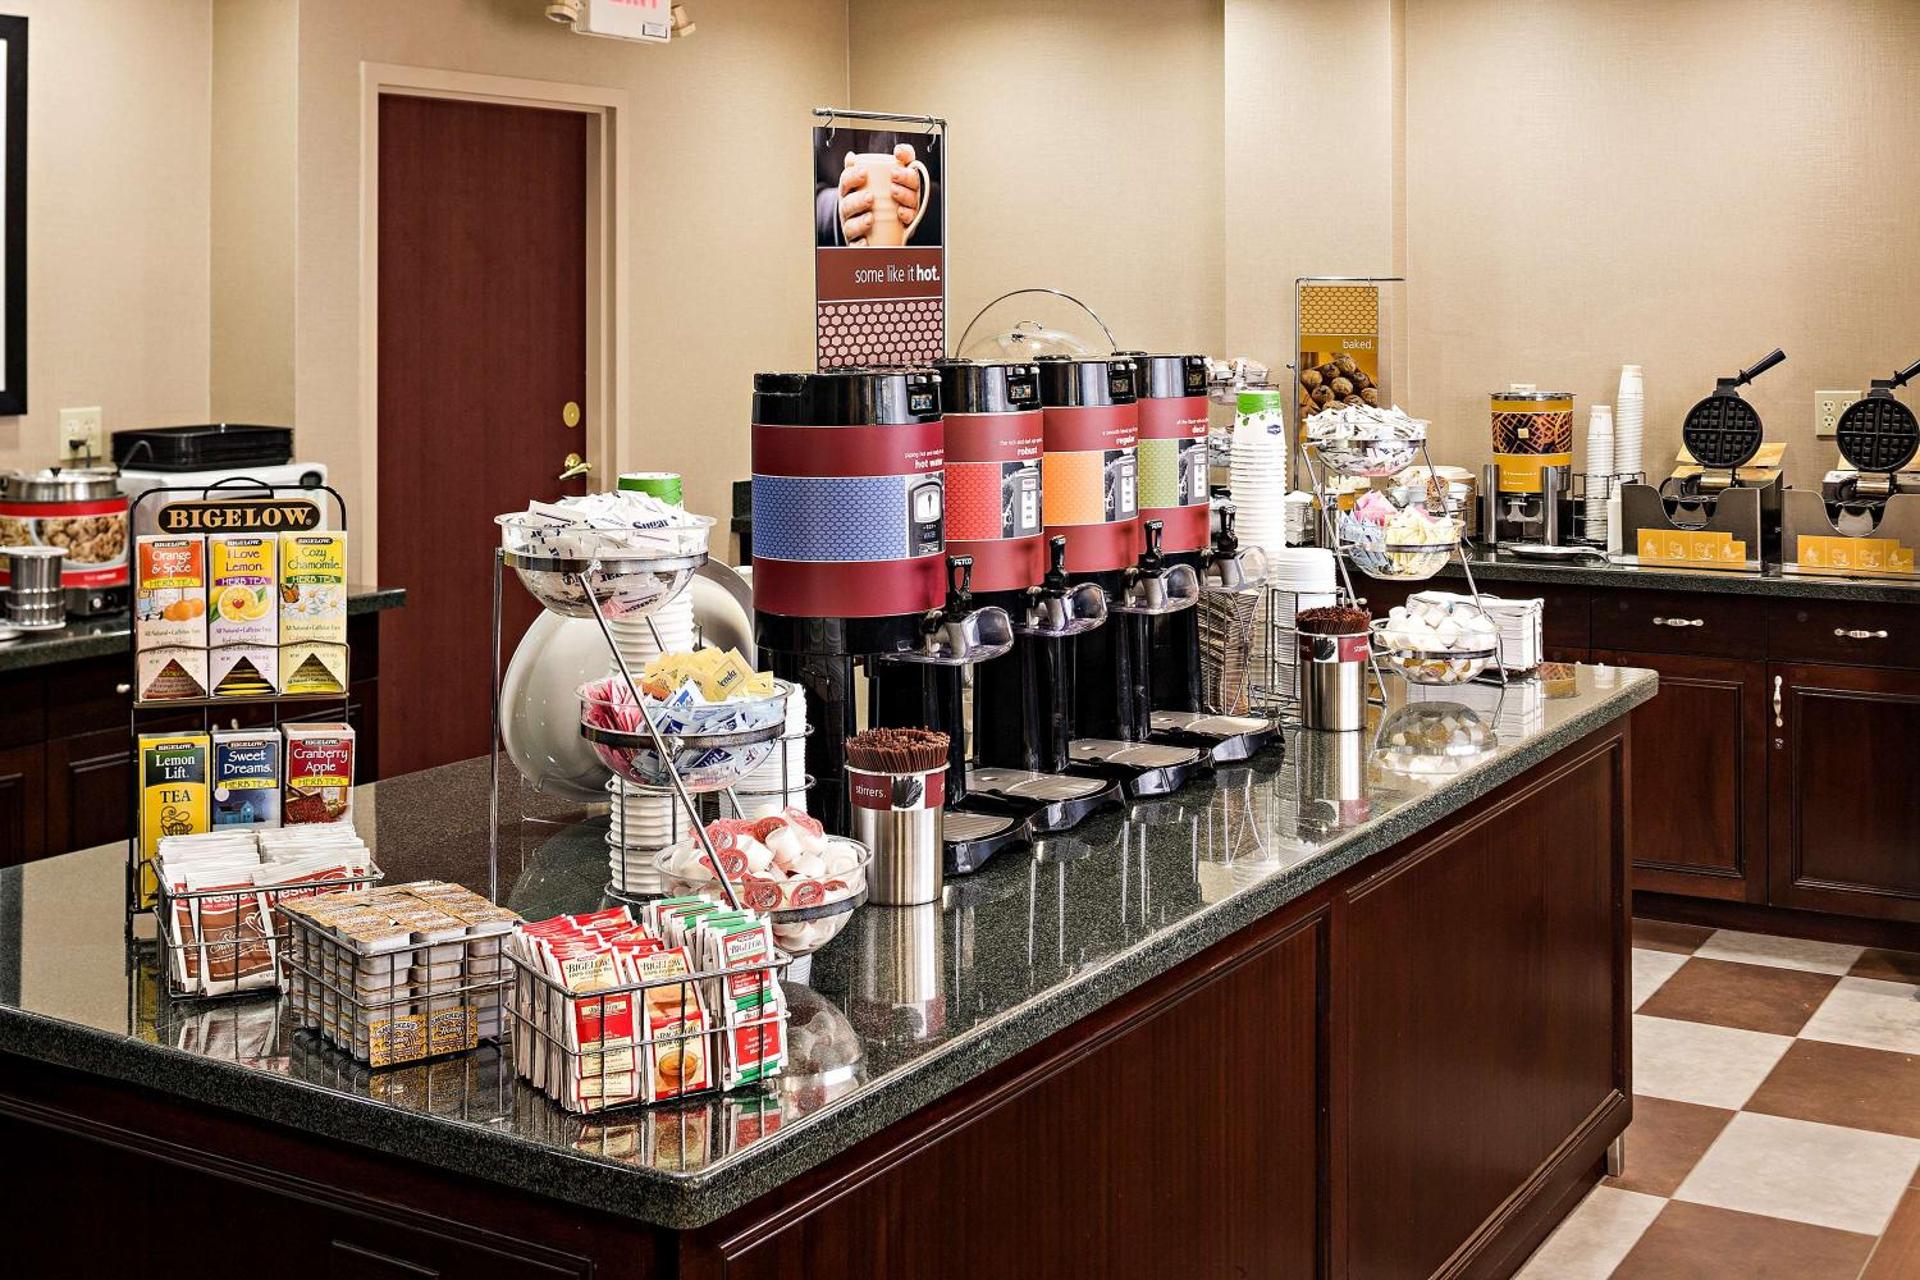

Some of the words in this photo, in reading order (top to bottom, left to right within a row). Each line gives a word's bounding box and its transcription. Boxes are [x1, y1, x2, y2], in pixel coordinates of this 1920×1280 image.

[854, 269, 884, 283] some
[887, 264, 904, 282] like
[907, 264, 914, 282] it
[916, 263, 940, 281] hot.
[1017, 446, 1037, 456] robust
[914, 459, 929, 469] hot
[167, 507, 313, 528] BIGELOW
[632, 519, 669, 529] Sugar
[152, 550, 192, 564] Orange
[227, 550, 231, 558] I
[234, 550, 260, 558] Love
[302, 547, 327, 562] Cozy
[226, 562, 262, 572] Lemon
[287, 556, 340, 570] Chamomile
[152, 564, 161, 574] &
[163, 563, 192, 578] Spice
[150, 579, 174, 588] HERB
[177, 578, 194, 586] TEA
[223, 577, 247, 586] HERB
[248, 576, 267, 585] TEA
[293, 575, 316, 584] HERB
[318, 575, 337, 583] TEA
[155, 754, 196, 767] Lemon
[228, 750, 267, 762] Sweet
[293, 746, 348, 764] Cranberry
[304, 758, 337, 777] Apple
[224, 780, 251, 789] HERB
[298, 777, 325, 786] HERB
[326, 777, 343, 785] TEA
[160, 789, 193, 803] TEA
